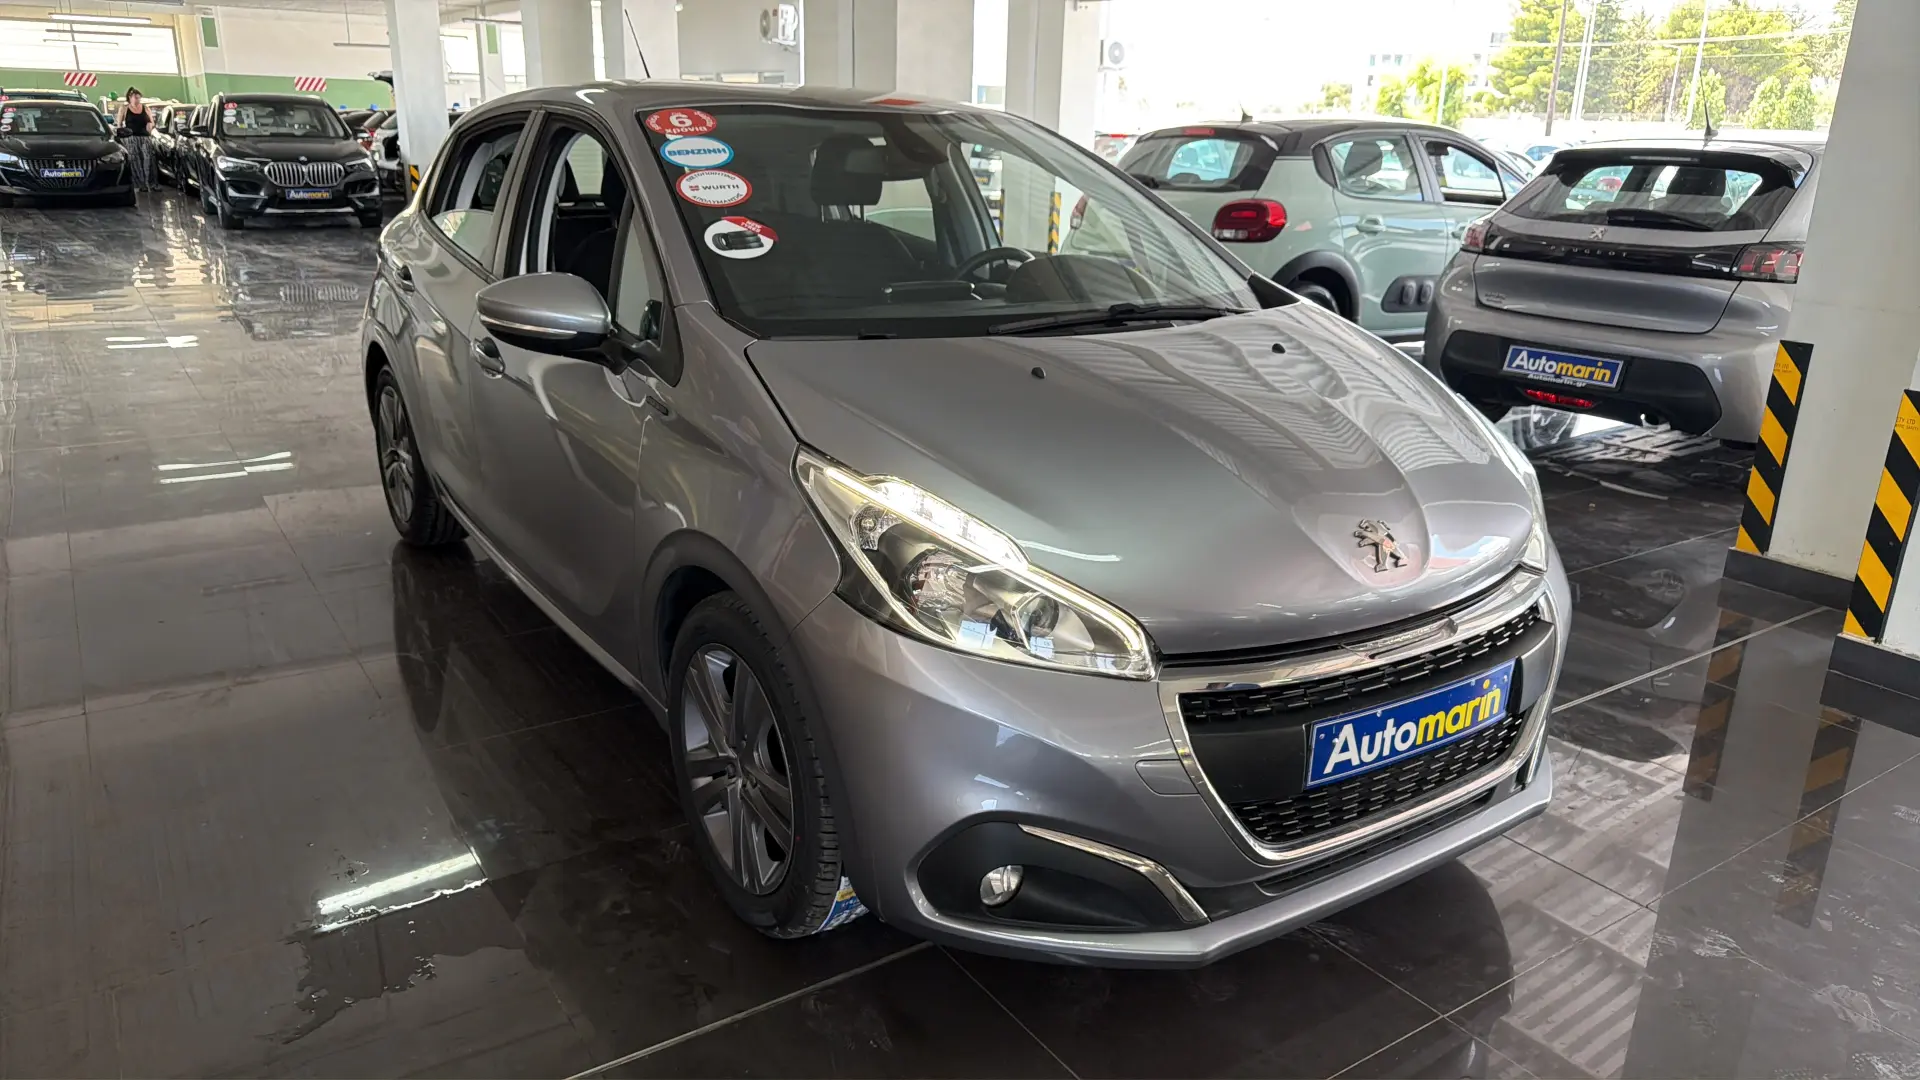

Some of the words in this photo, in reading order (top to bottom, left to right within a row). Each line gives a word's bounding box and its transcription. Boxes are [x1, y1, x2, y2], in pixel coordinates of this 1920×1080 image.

[669, 113, 693, 128] 6
[43, 169, 82, 178] Automarin
[289, 190, 330, 199] Automarin
[1511, 350, 1612, 383] Automarin
[1323, 678, 1502, 775] Automarin
